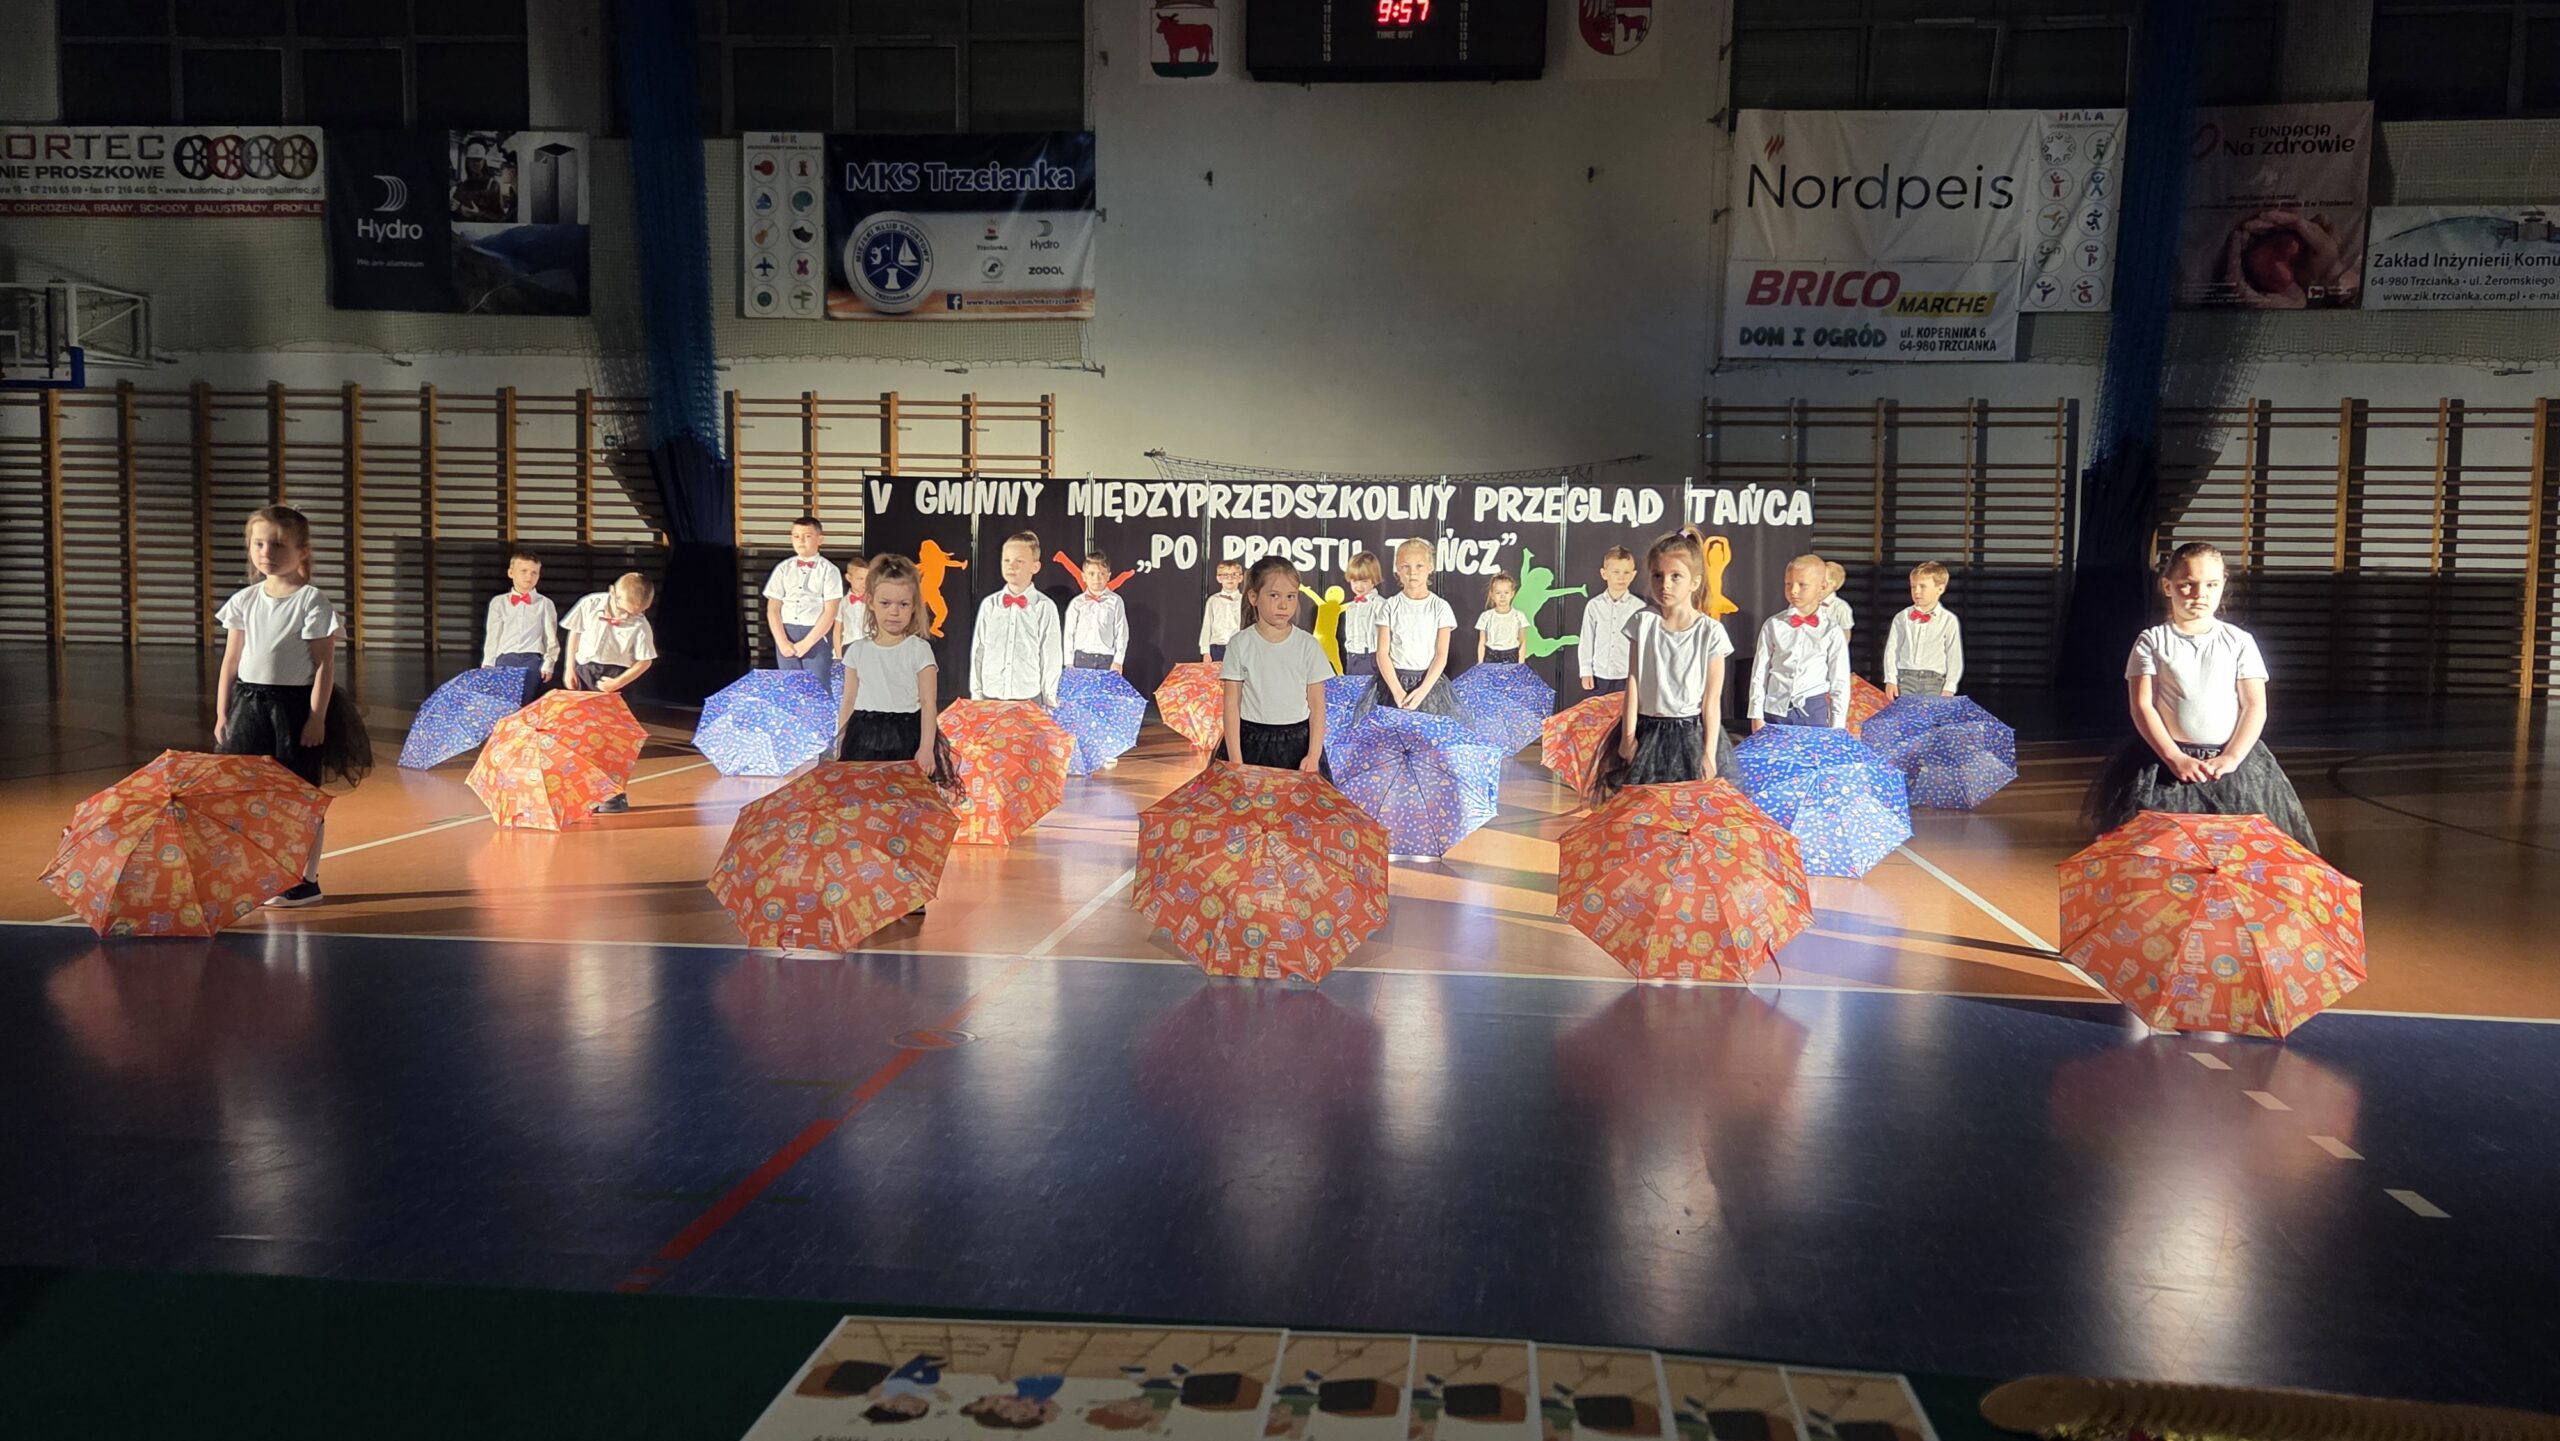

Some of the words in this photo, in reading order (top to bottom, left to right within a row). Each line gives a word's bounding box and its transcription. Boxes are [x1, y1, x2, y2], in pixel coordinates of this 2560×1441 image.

[1377, 0, 1430, 23] 9:57
[1323, 53, 1332, 62] 15
[1459, 51, 1468, 61] 15
[2249, 124, 2331, 139] FUNDACJA
[2223, 140, 2254, 156] Na
[2262, 134, 2356, 155] zdrowie
[35, 166, 164, 179] PROSZKOWE
[846, 162, 921, 192] MKS
[923, 160, 1076, 192] Trzcianka
[1747, 163, 2014, 218] Nordpeis
[273, 203, 321, 213] PROFILE
[357, 218, 424, 243] Hydro
[855, 230, 875, 263] MIEJSKI
[875, 223, 898, 233] KLUB
[899, 223, 930, 263] SPORTOWY
[1030, 240, 1060, 251] Hydro
[2373, 253, 2430, 267] Zakład
[2434, 253, 2510, 270] Inżynierii
[2371, 276, 2408, 286] 64-980
[2411, 276, 2460, 286] Trzcianka
[2469, 276, 2482, 286] ul.
[2484, 275, 2555, 287] Żeromskiego
[1745, 270, 1901, 308] BRICO
[1896, 295, 1988, 313] MARCHÉ
[2383, 291, 2520, 303] www.zik.trzcianka.com.pl
[1740, 325, 1785, 347] DOM
[1792, 326, 1806, 347] I
[1813, 322, 1887, 348] OGRÓD
[1901, 327, 1914, 339] ul.
[1916, 327, 1978, 339] KOPERNIKA
[1979, 327, 1986, 339] 6
[1899, 339, 1936, 352] 64-980
[1938, 339, 1997, 352] TRZCIANKA
[870, 479, 893, 514] V
[914, 480, 1044, 517] GMINNY
[1067, 481, 1456, 524] MIĘDZYPRZEDSZKOLNY
[1474, 486, 1665, 528] PRZEGLĄD
[1690, 483, 1814, 527] TAŃCA
[1384, 528, 1518, 575] TŃCZ”
